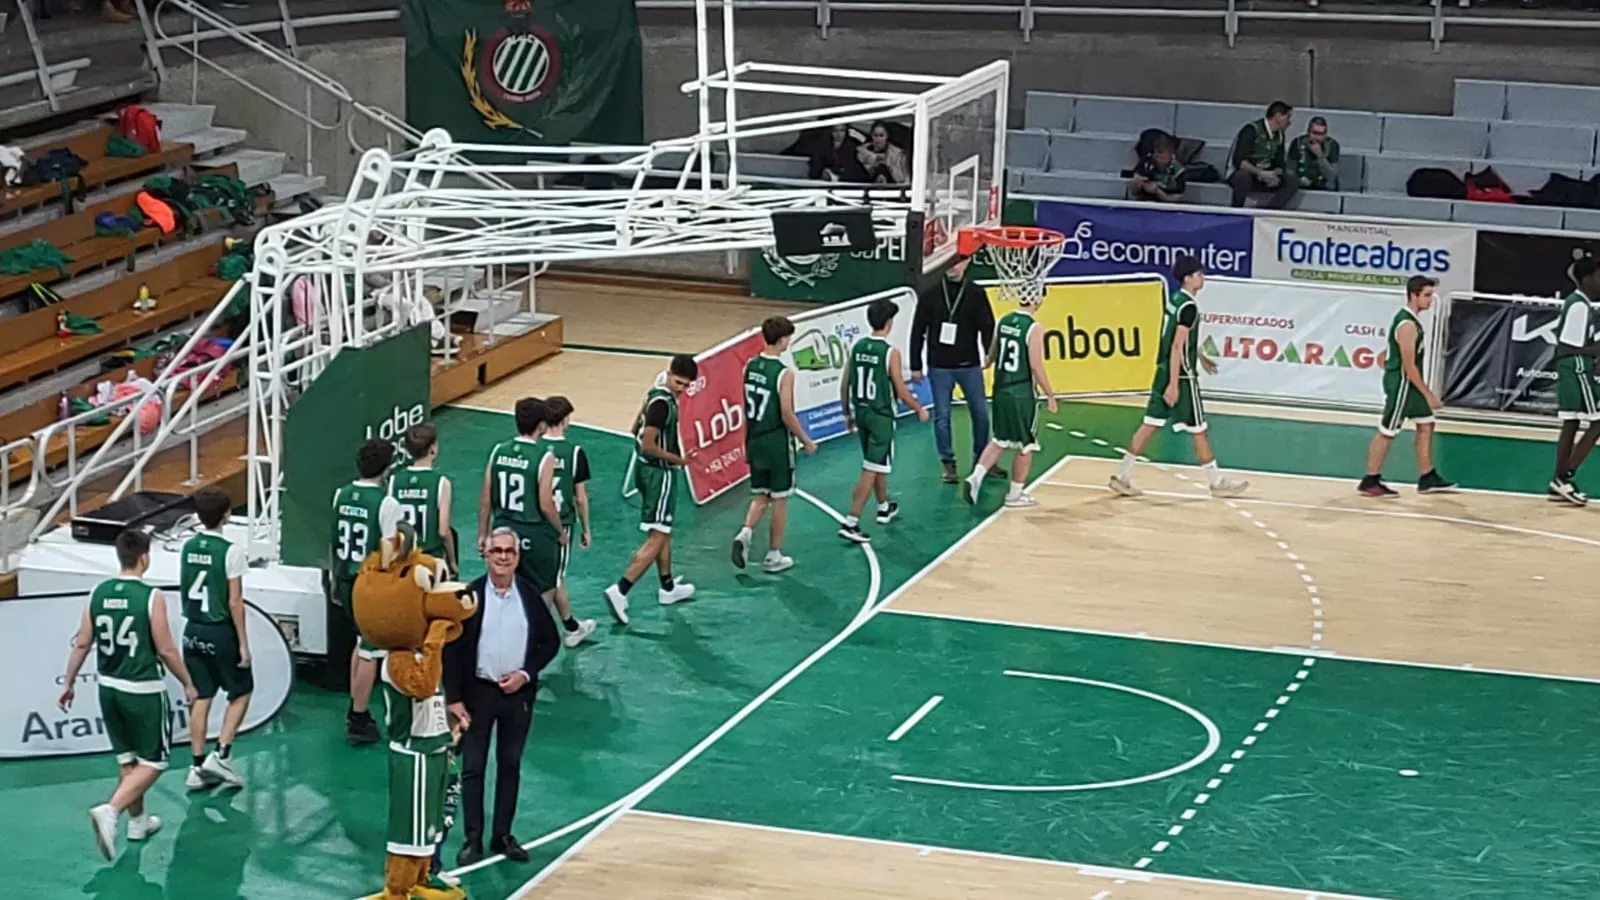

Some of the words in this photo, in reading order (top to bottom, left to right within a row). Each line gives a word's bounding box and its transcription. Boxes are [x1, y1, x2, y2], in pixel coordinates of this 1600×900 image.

[1277, 228, 1450, 272] Fontecabras
[1327, 224, 1391, 237] MANANTIAL
[1327, 272, 1378, 284] MINERAL
[1345, 324, 1376, 336] CASH
[998, 337, 1020, 373] 13
[1516, 367, 1559, 380] Automo
[744, 383, 771, 422] 57
[857, 366, 877, 401] 16
[694, 398, 744, 449] Lob
[498, 471, 525, 512] 12
[336, 519, 369, 563] 33
[187, 569, 209, 613] 4
[95, 614, 139, 659] 34
